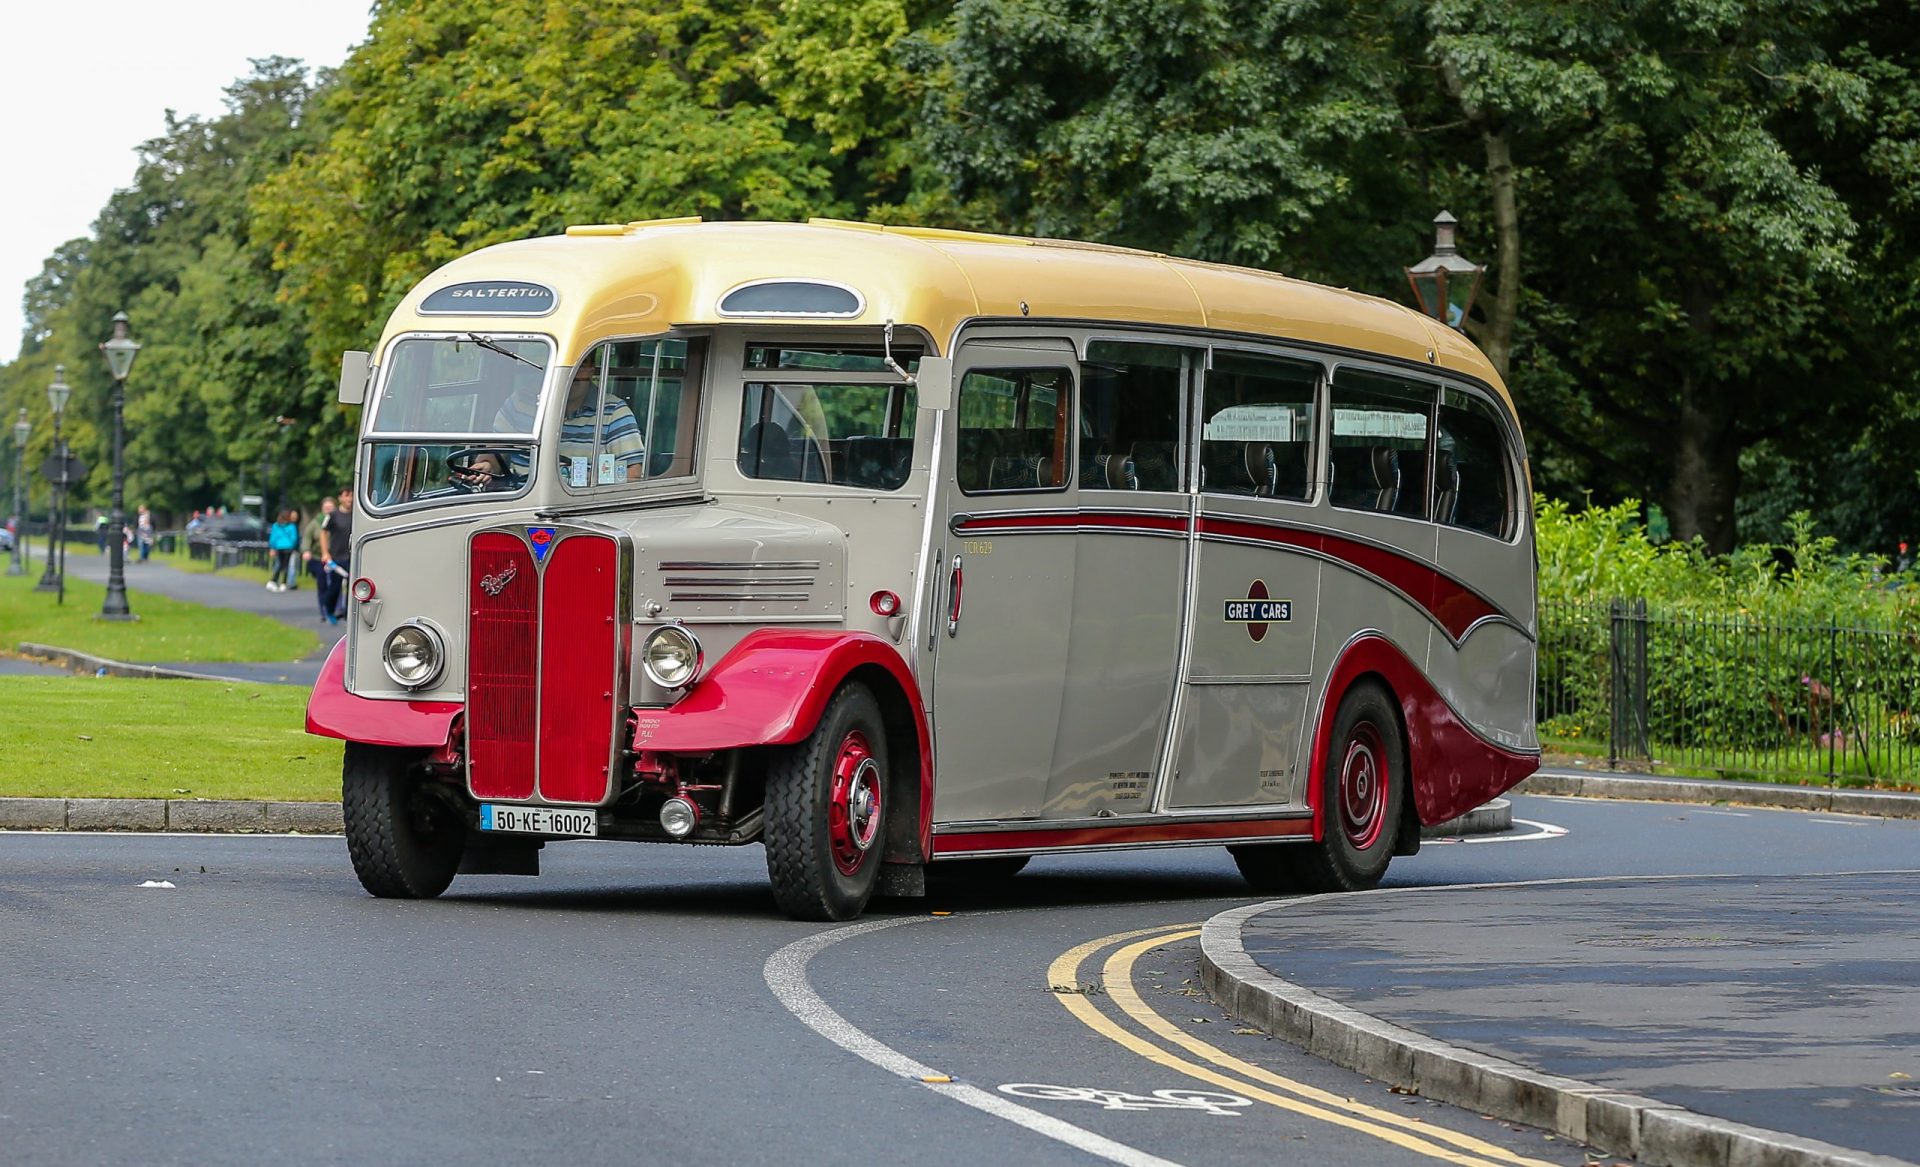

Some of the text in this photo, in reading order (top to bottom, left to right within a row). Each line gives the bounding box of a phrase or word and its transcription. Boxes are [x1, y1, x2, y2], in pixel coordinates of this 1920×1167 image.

[1228, 603, 1288, 619] GREY CARS
[497, 811, 591, 834] 50-KE-16002
